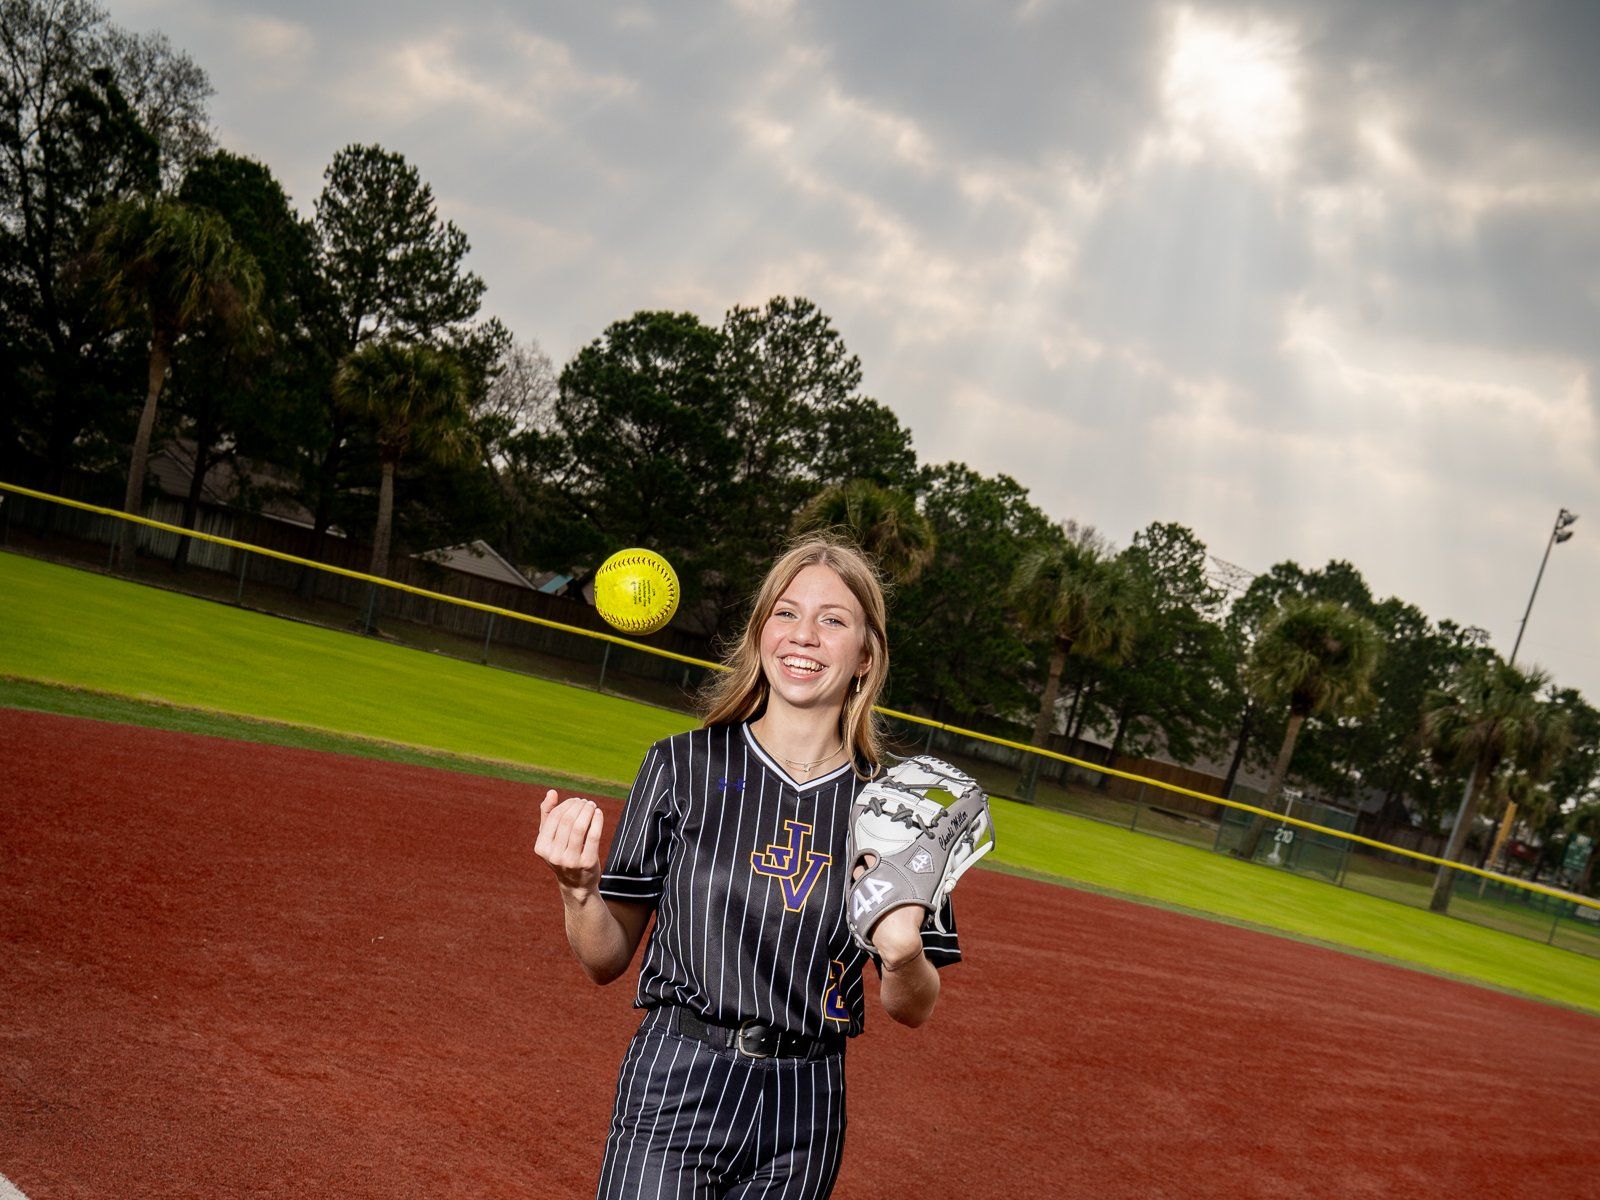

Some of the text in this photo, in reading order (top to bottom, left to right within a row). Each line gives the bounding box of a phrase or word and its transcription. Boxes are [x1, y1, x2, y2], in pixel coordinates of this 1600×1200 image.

[1274, 828, 1294, 844] 210
[911, 853, 929, 872] 44
[852, 877, 894, 920] 44
